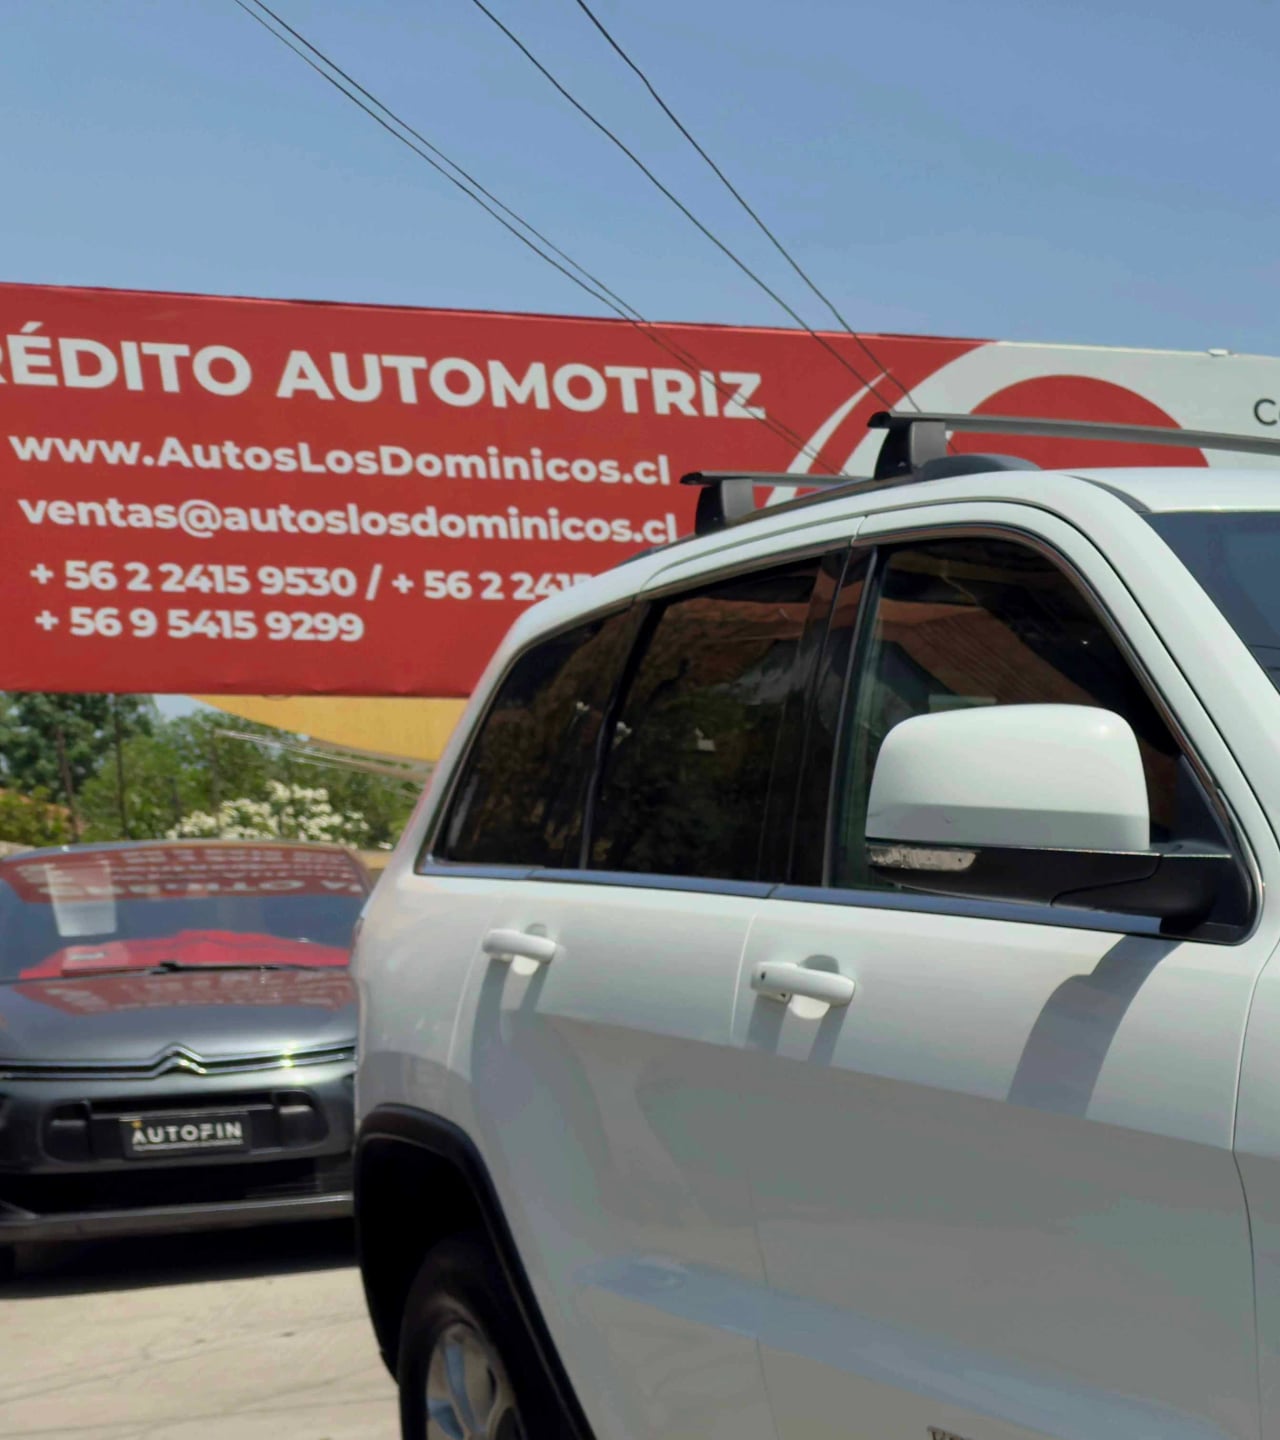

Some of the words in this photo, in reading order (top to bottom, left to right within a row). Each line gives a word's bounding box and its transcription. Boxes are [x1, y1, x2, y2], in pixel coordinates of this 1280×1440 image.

[0, 321, 252, 397] ÉDITO
[277, 350, 765, 419] AUTOMOTRIZ
[9, 435, 671, 486] www.AutosLosDominicos.cl
[18, 497, 678, 544] ventas@autoslosdominicos.cl
[66, 560, 117, 590] 56
[124, 562, 152, 591] 2
[159, 563, 250, 594] 2415
[258, 566, 357, 596] 9530
[425, 570, 472, 599] 56
[479, 571, 504, 600] 2
[71, 607, 122, 636] 56
[130, 608, 157, 637] 9
[168, 609, 258, 639] 5415
[265, 611, 364, 640] 9299
[132, 1121, 242, 1144] AUTOFIN
